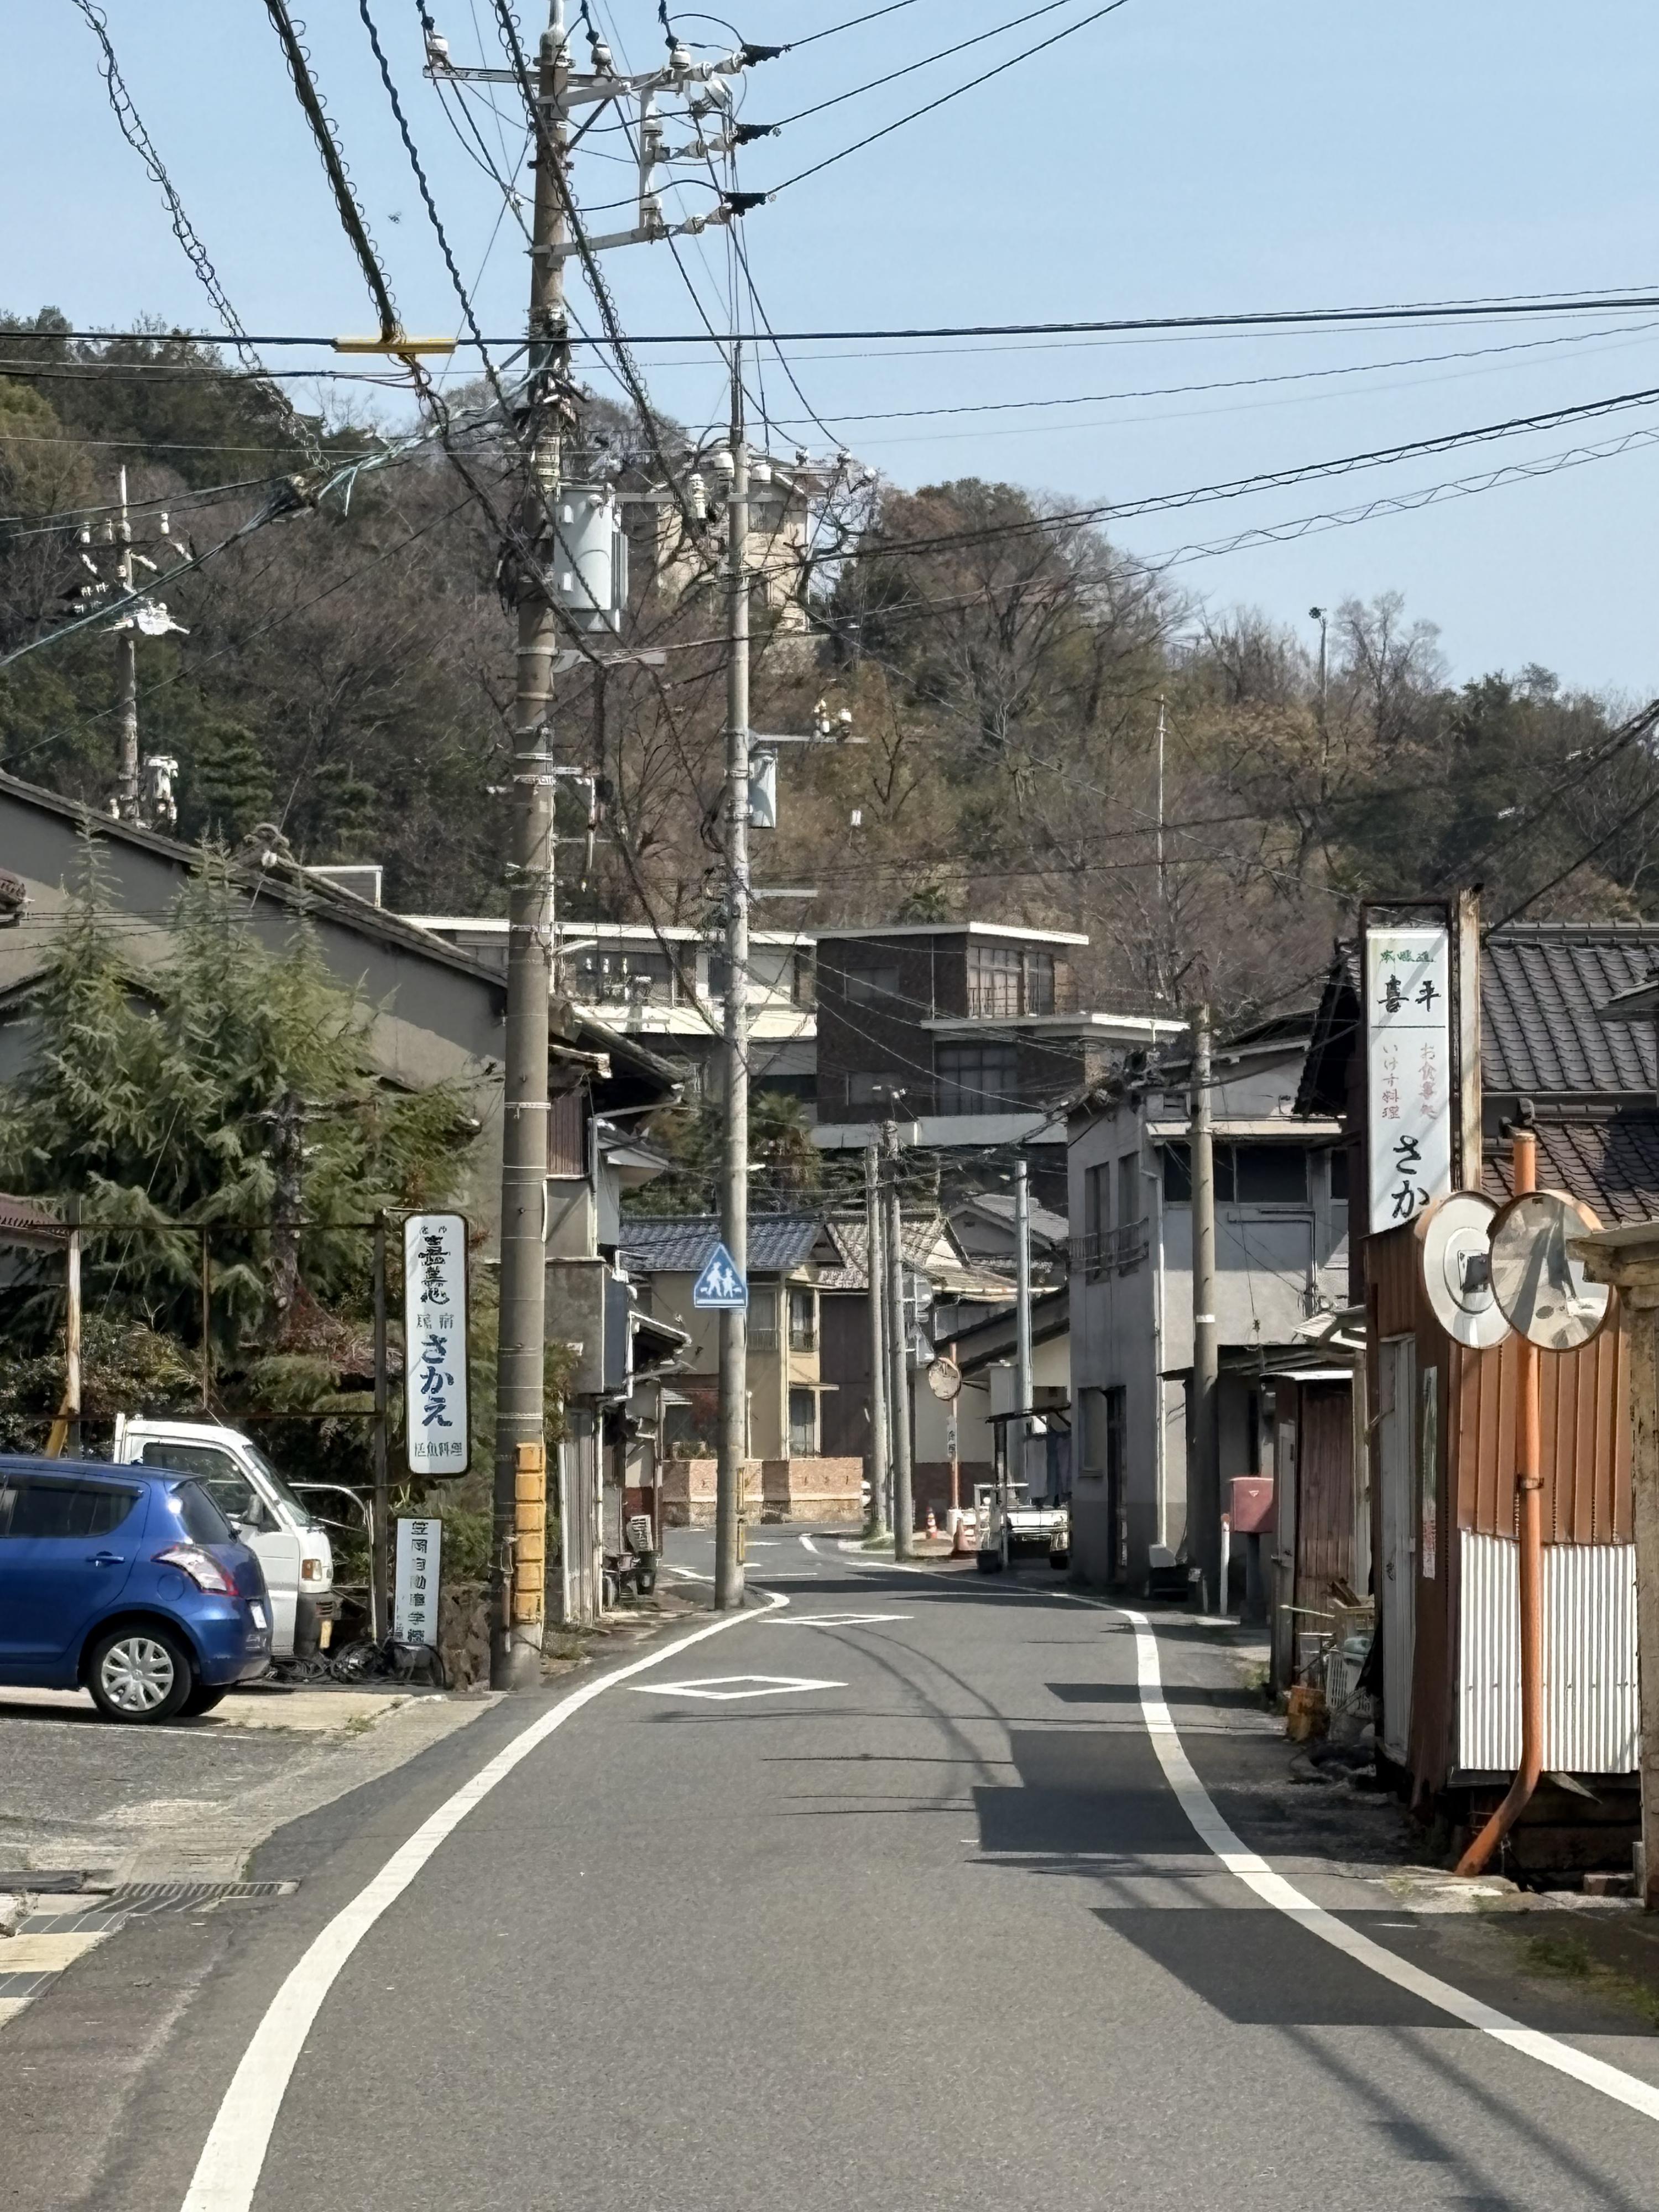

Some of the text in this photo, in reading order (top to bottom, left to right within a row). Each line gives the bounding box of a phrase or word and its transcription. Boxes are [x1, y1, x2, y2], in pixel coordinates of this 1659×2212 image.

[1377, 974, 1441, 1013] 喜平
[1381, 1044, 1400, 1119] いけす料理
[420, 1334, 455, 1427] さかえ
